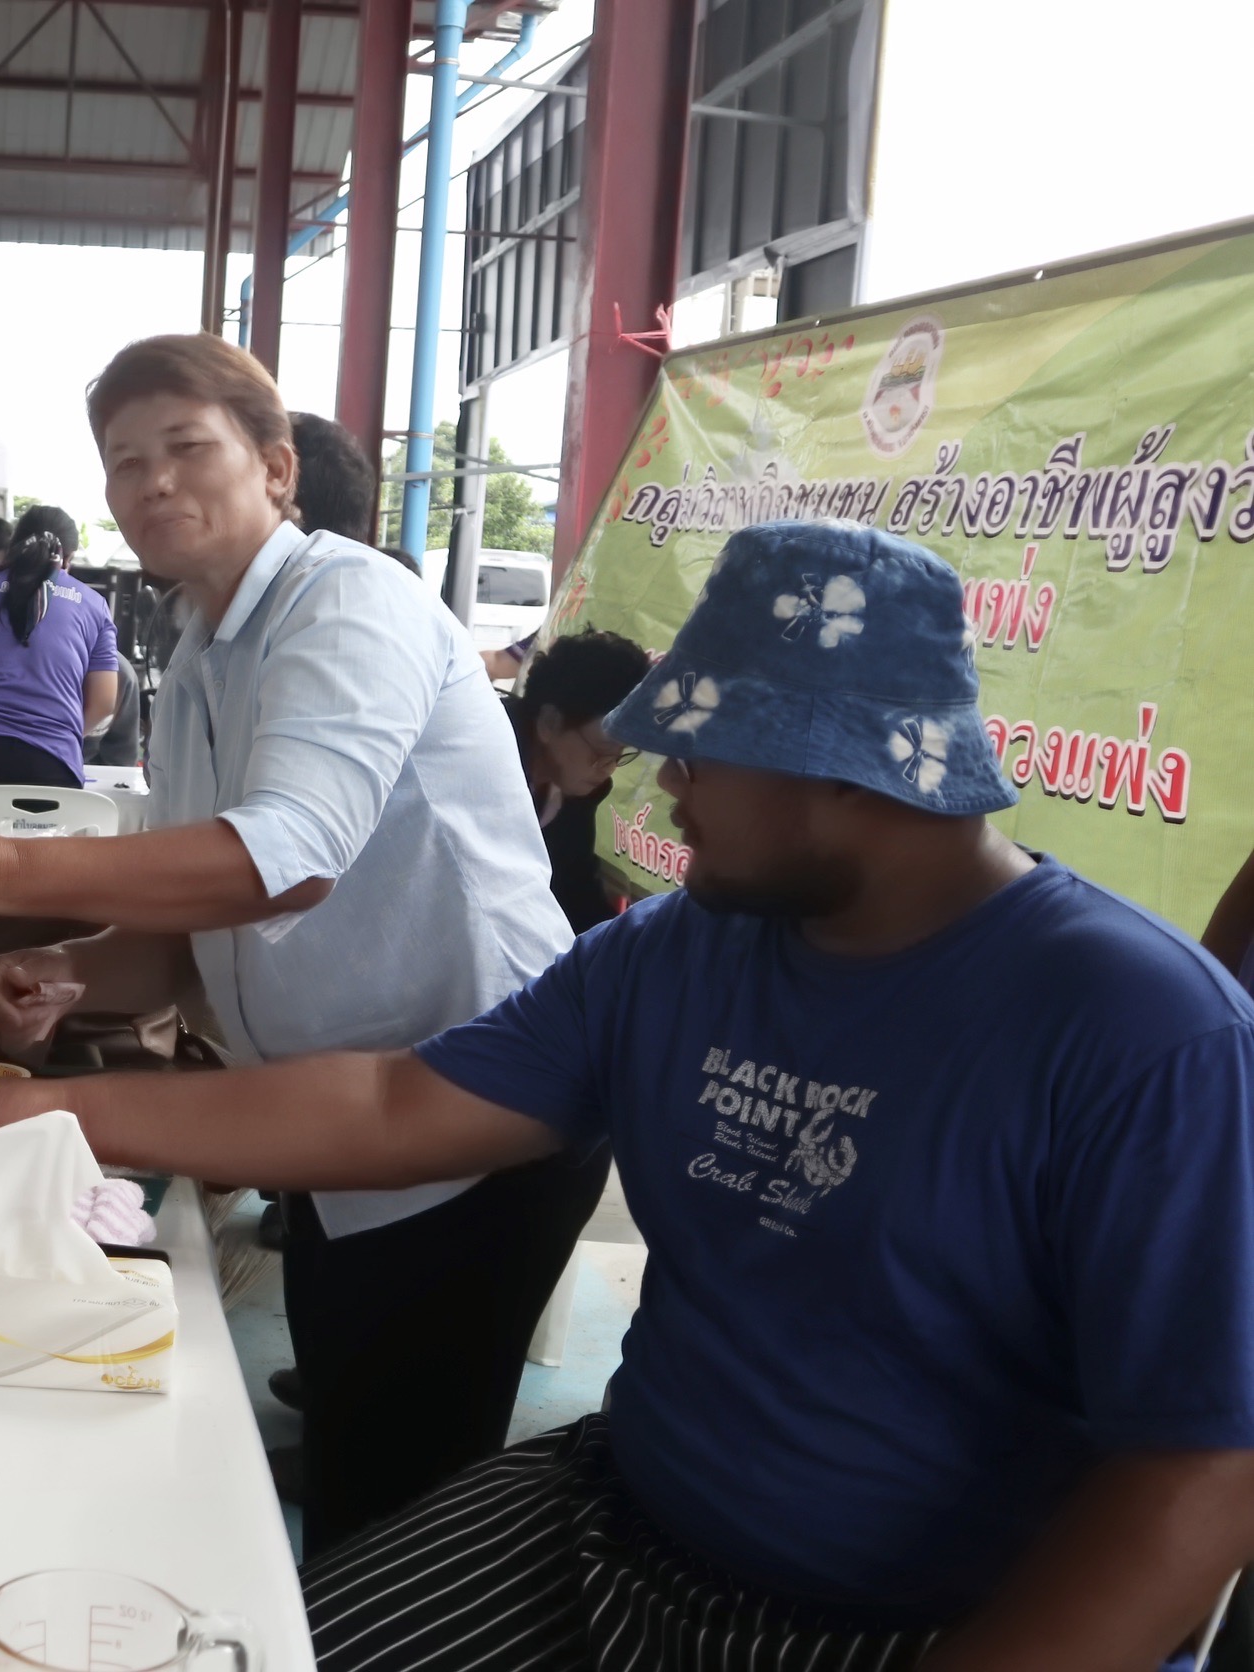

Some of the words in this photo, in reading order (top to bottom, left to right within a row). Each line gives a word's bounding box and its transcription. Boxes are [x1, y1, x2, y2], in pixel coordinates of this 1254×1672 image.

[887, 422, 1254, 574] สร้างอาชีพผู้สูงว
[702, 1047, 800, 1104] BLACK
[804, 1081, 878, 1118] ROCK
[698, 1079, 801, 1137] POINT
[716, 1121, 742, 1138] Block
[714, 1131, 743, 1150] Rhode
[688, 1153, 759, 1192] Crab
